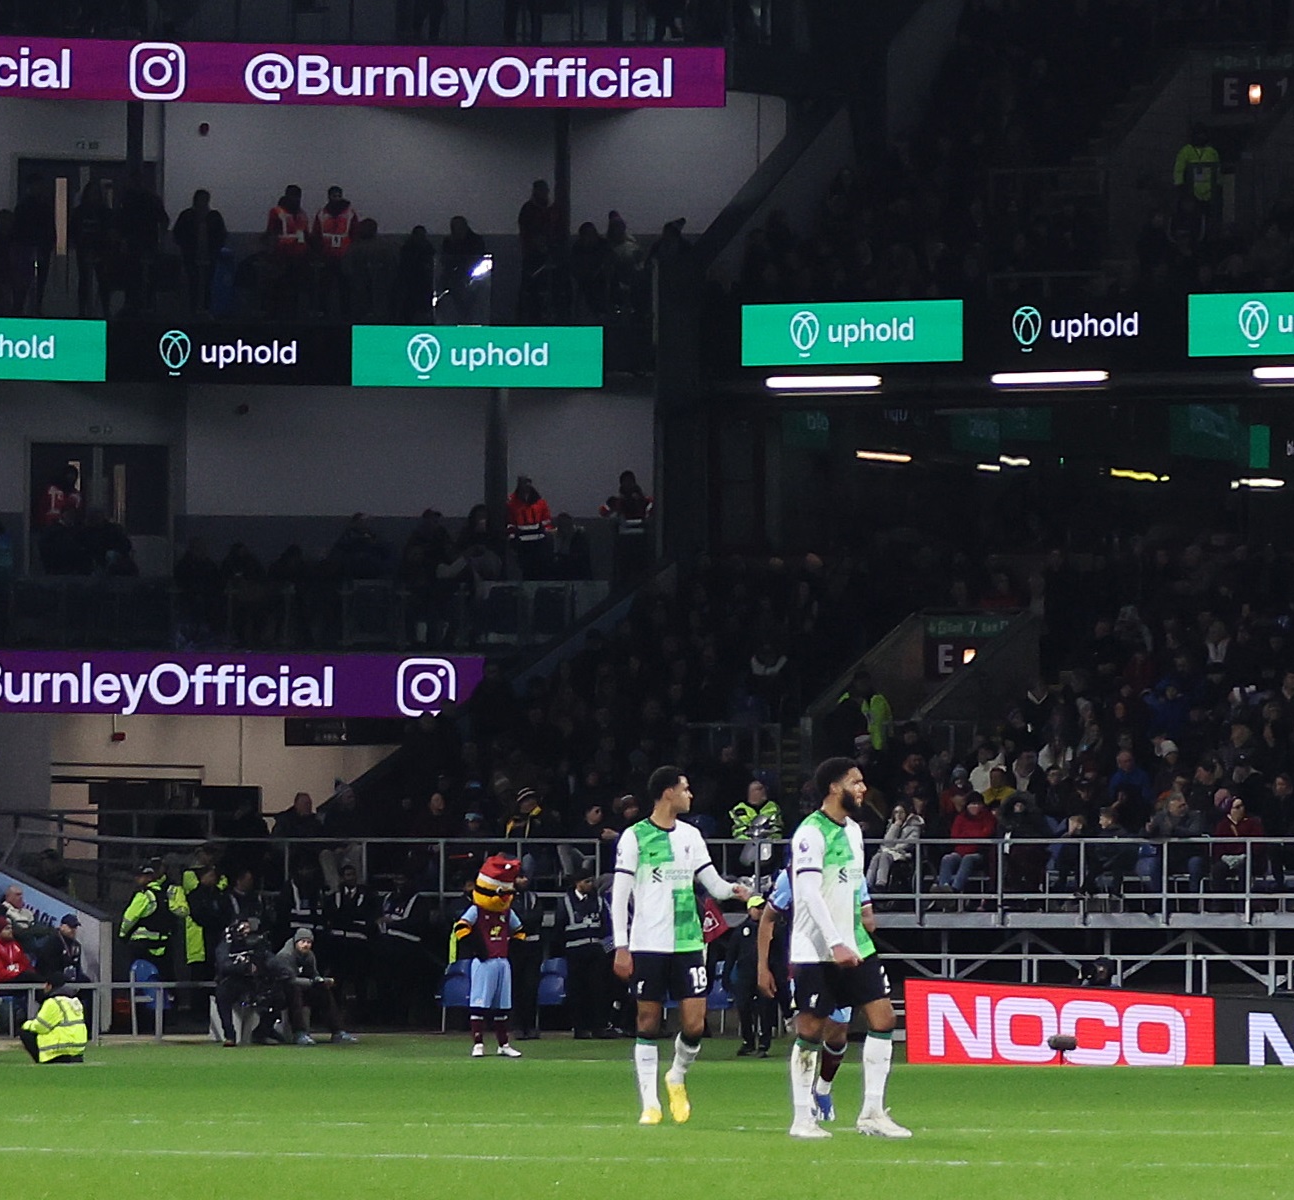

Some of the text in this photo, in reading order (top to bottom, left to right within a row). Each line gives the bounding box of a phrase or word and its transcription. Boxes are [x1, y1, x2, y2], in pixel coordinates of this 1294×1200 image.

[244, 52, 672, 108] @BurnleyOfficial
[828, 316, 914, 347] uphold
[1051, 311, 1139, 343] uphold
[201, 339, 297, 369] uphold
[451, 342, 548, 372] uphold
[937, 643, 955, 674] E
[689, 966, 708, 987] 18
[928, 993, 1187, 1066] NOCO
